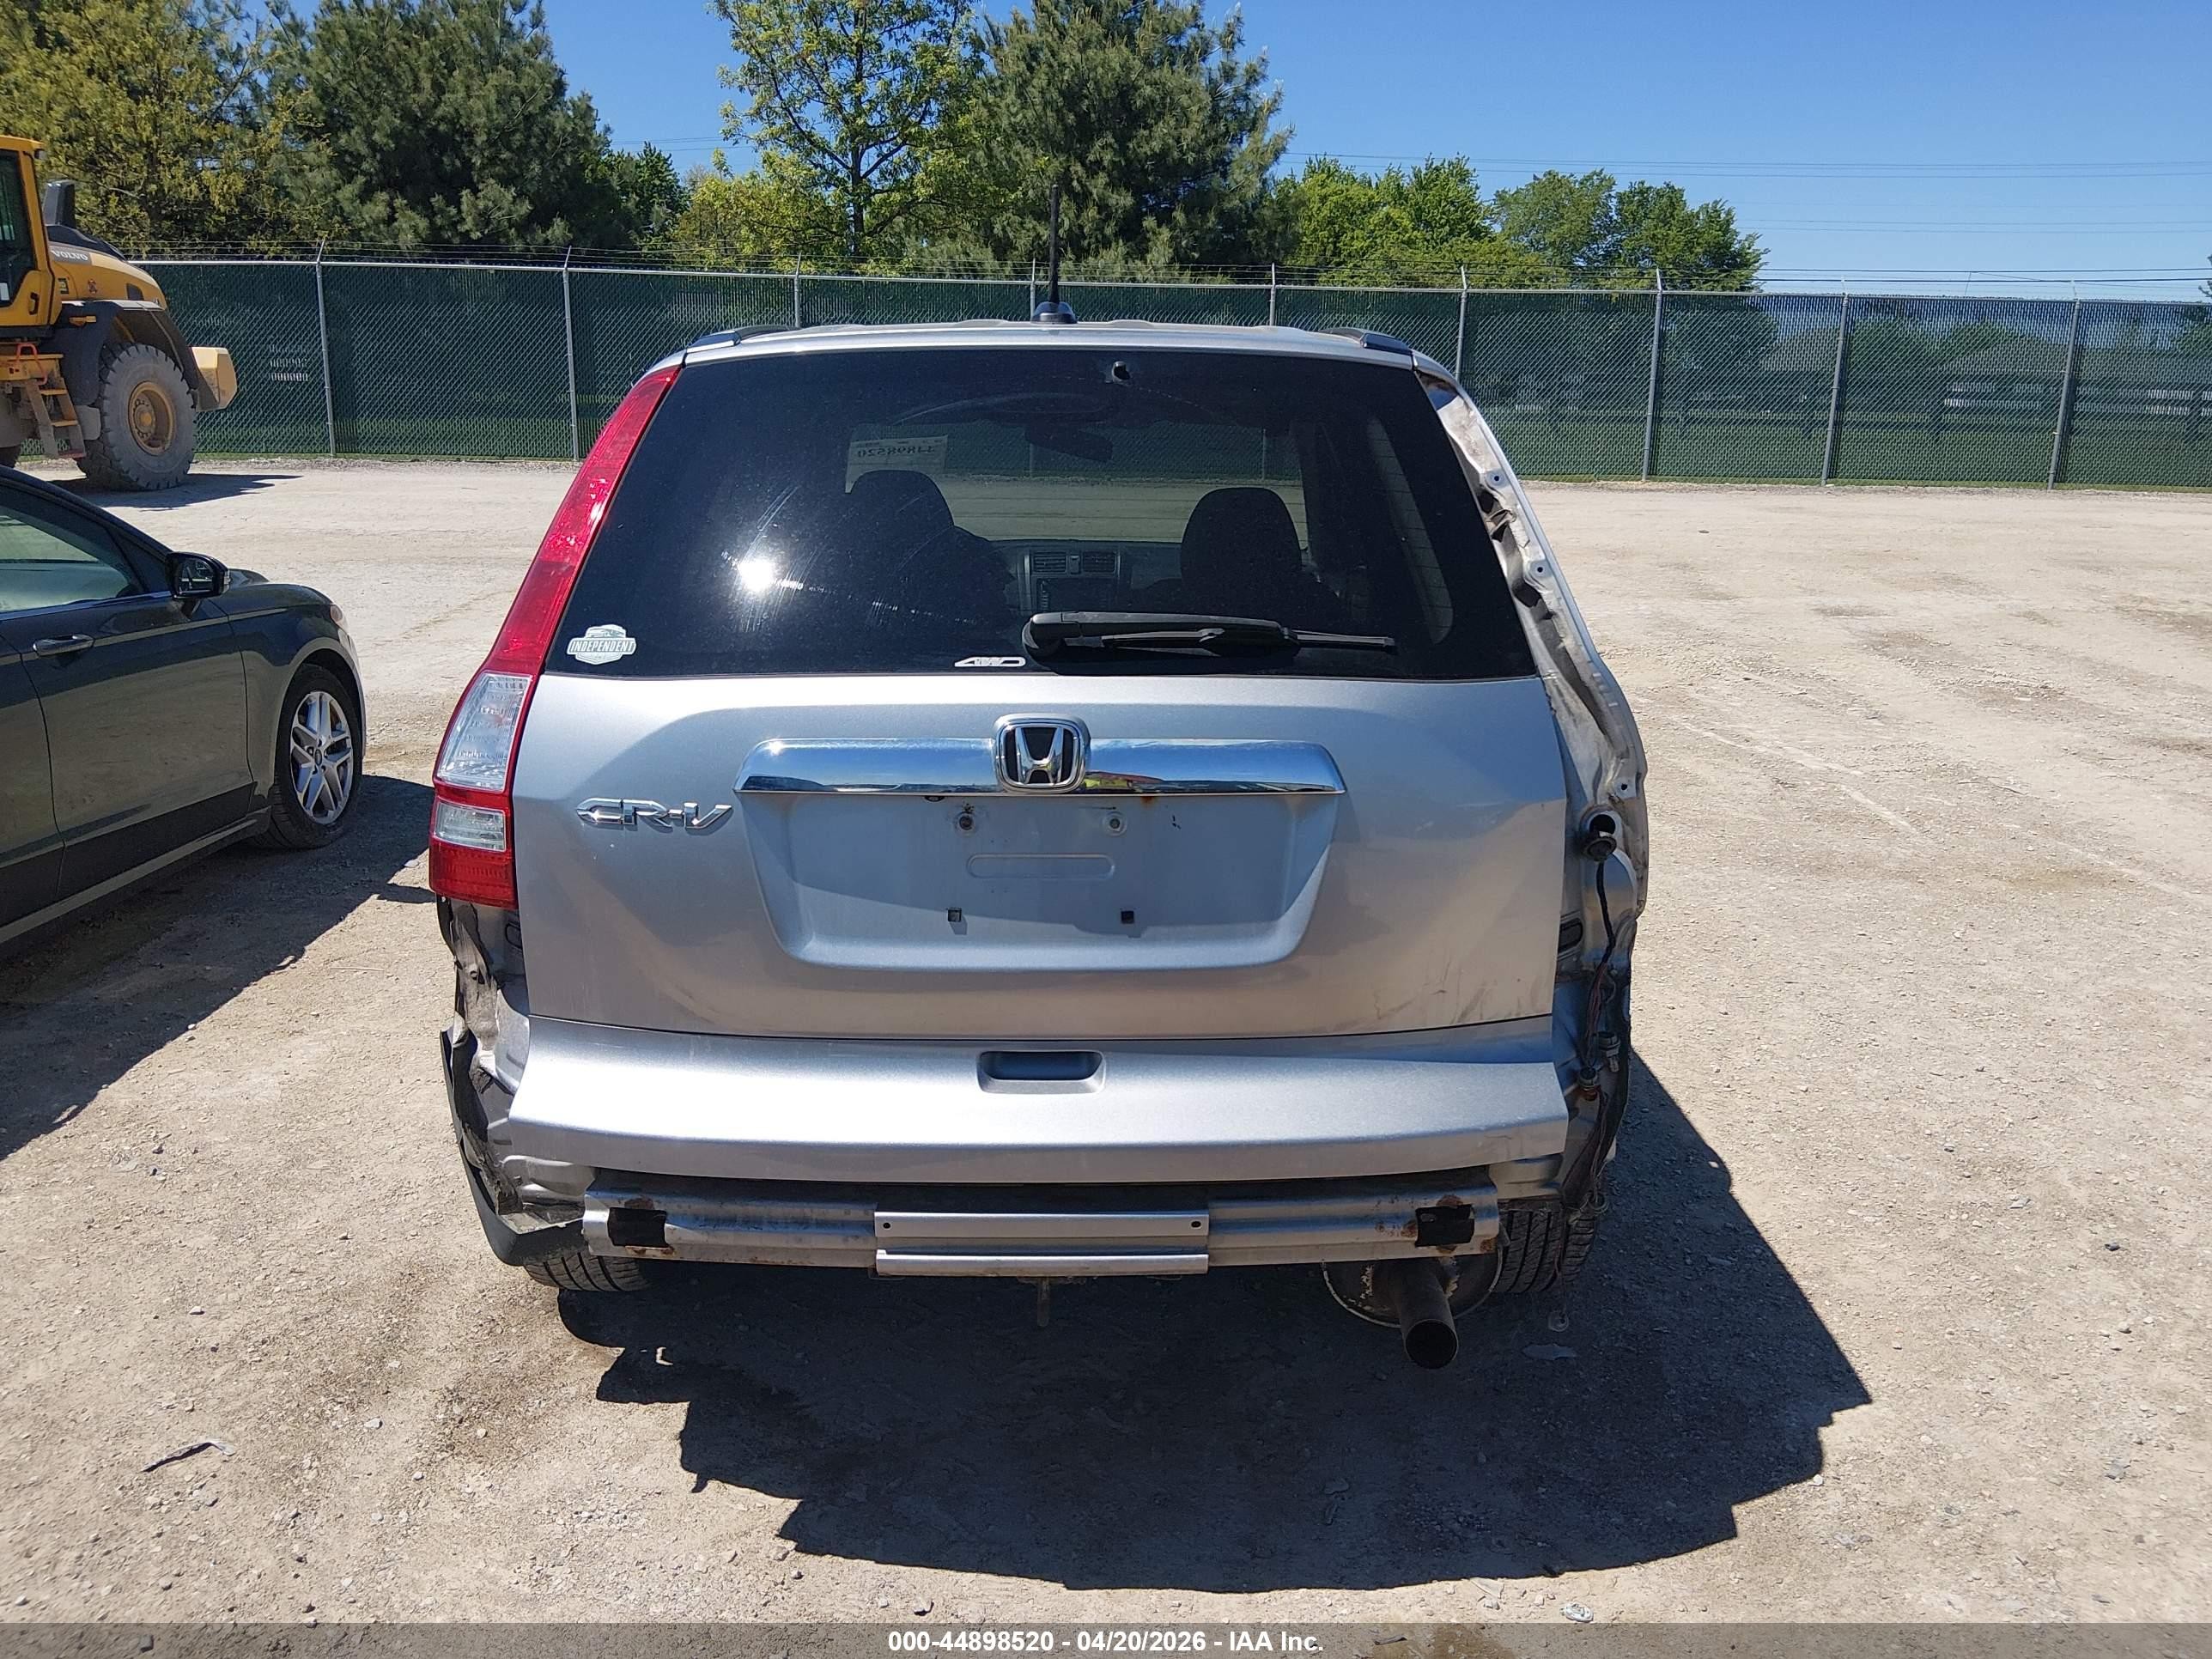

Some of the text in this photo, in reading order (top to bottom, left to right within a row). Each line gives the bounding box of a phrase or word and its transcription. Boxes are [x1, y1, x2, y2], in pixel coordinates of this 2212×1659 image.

[51, 250, 89, 261] VOLVO
[570, 640, 635, 653] INDEPENDENT
[576, 797, 732, 829] CR-V
